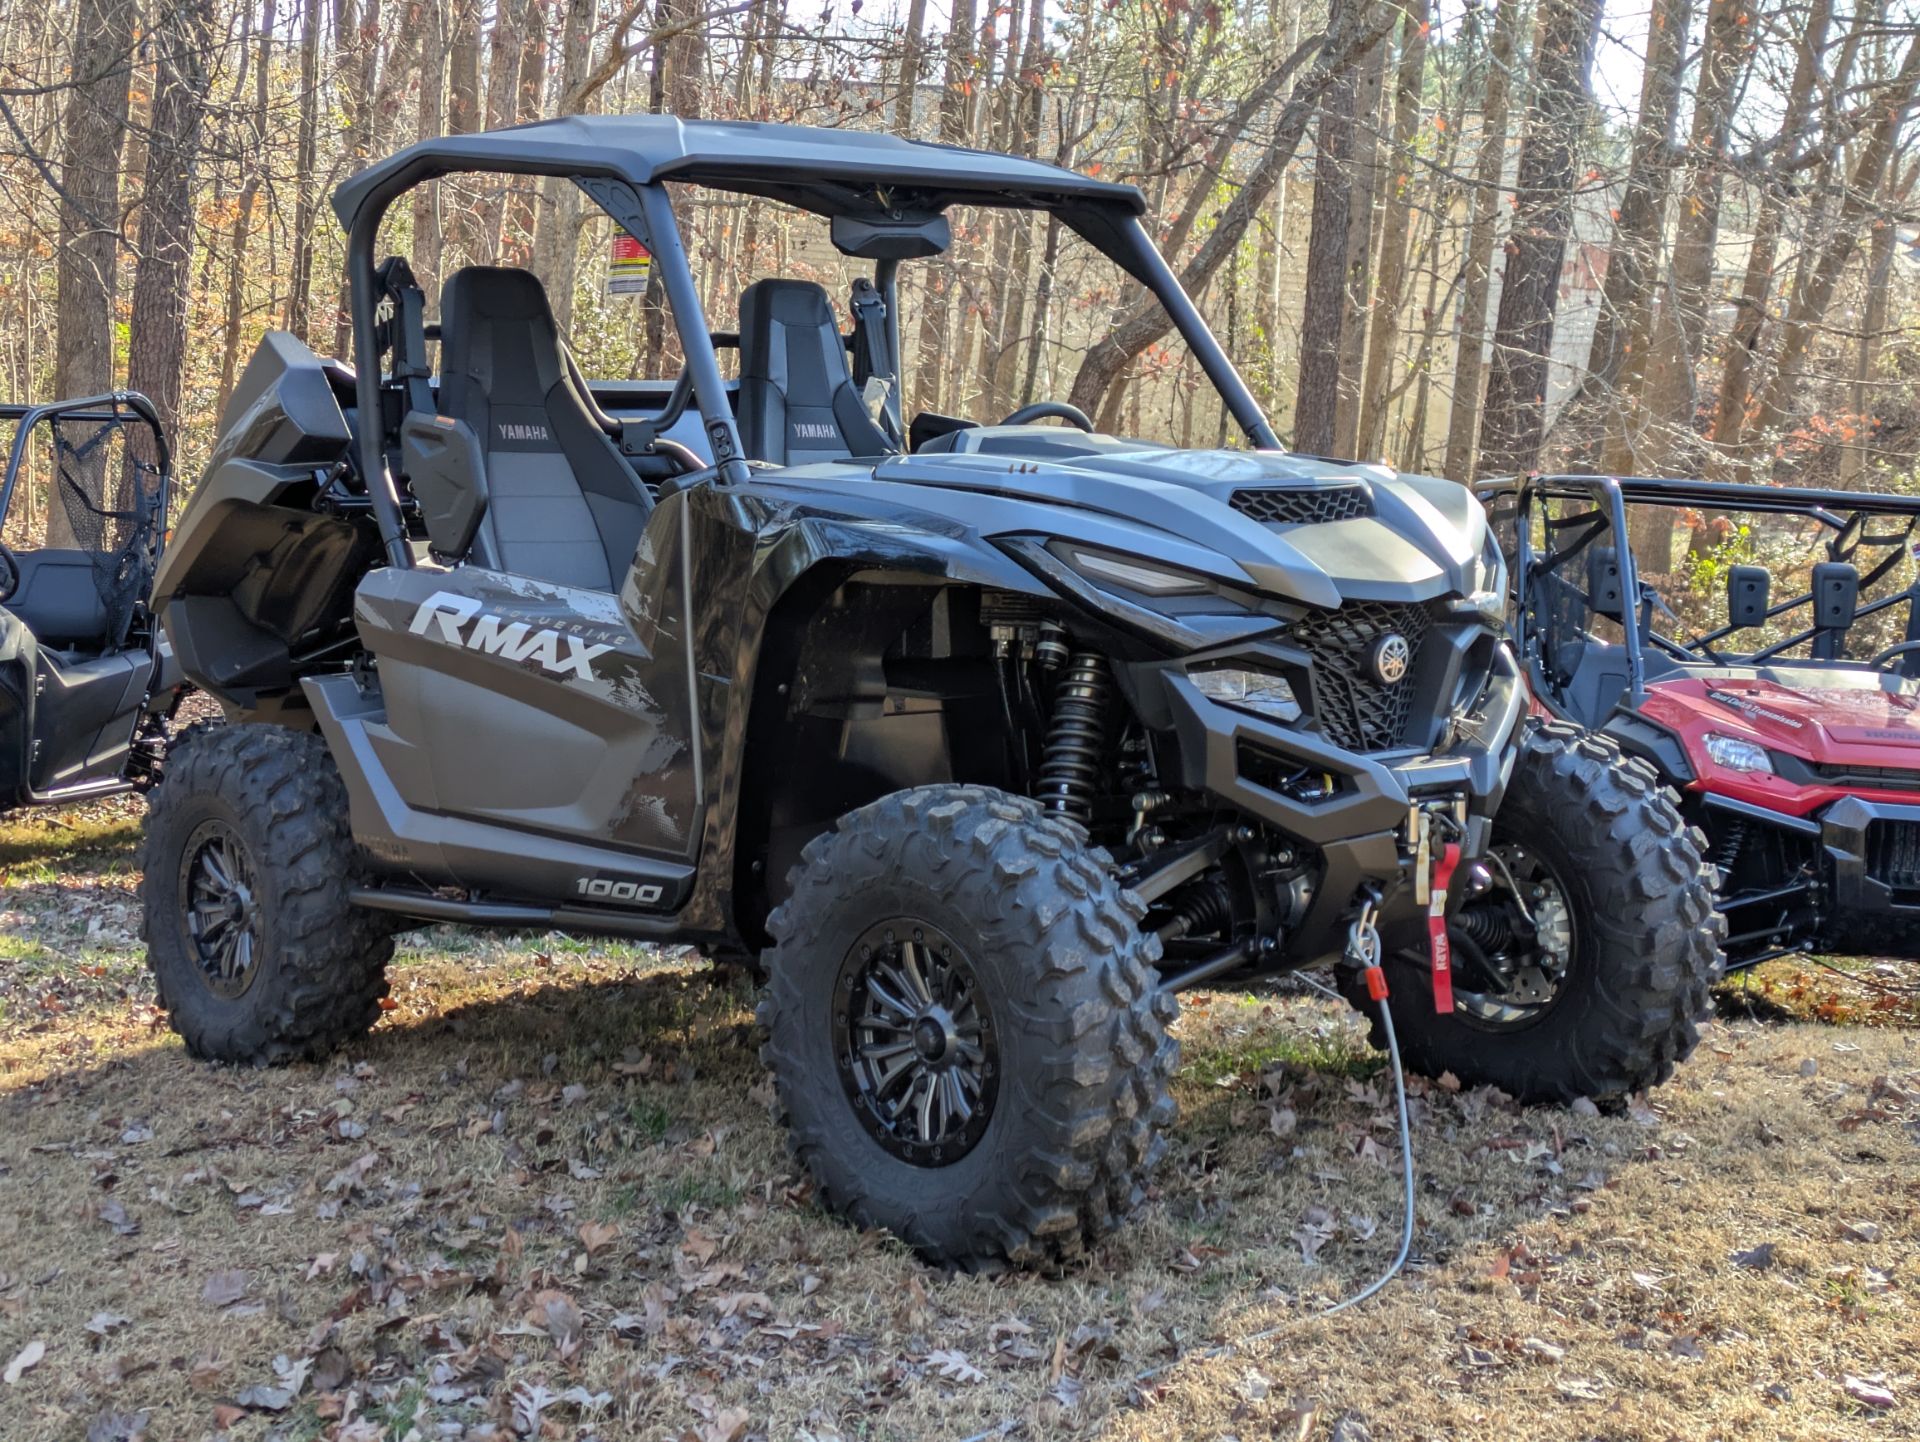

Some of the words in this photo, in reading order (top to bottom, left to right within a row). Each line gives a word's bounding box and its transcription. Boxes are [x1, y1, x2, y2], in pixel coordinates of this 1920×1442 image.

[498, 424, 549, 440] YAMAHA
[793, 423, 837, 438] YAMAHA
[408, 590, 616, 682] RMAX
[576, 877, 664, 903] 1000
[1434, 932, 1448, 971] WARN
